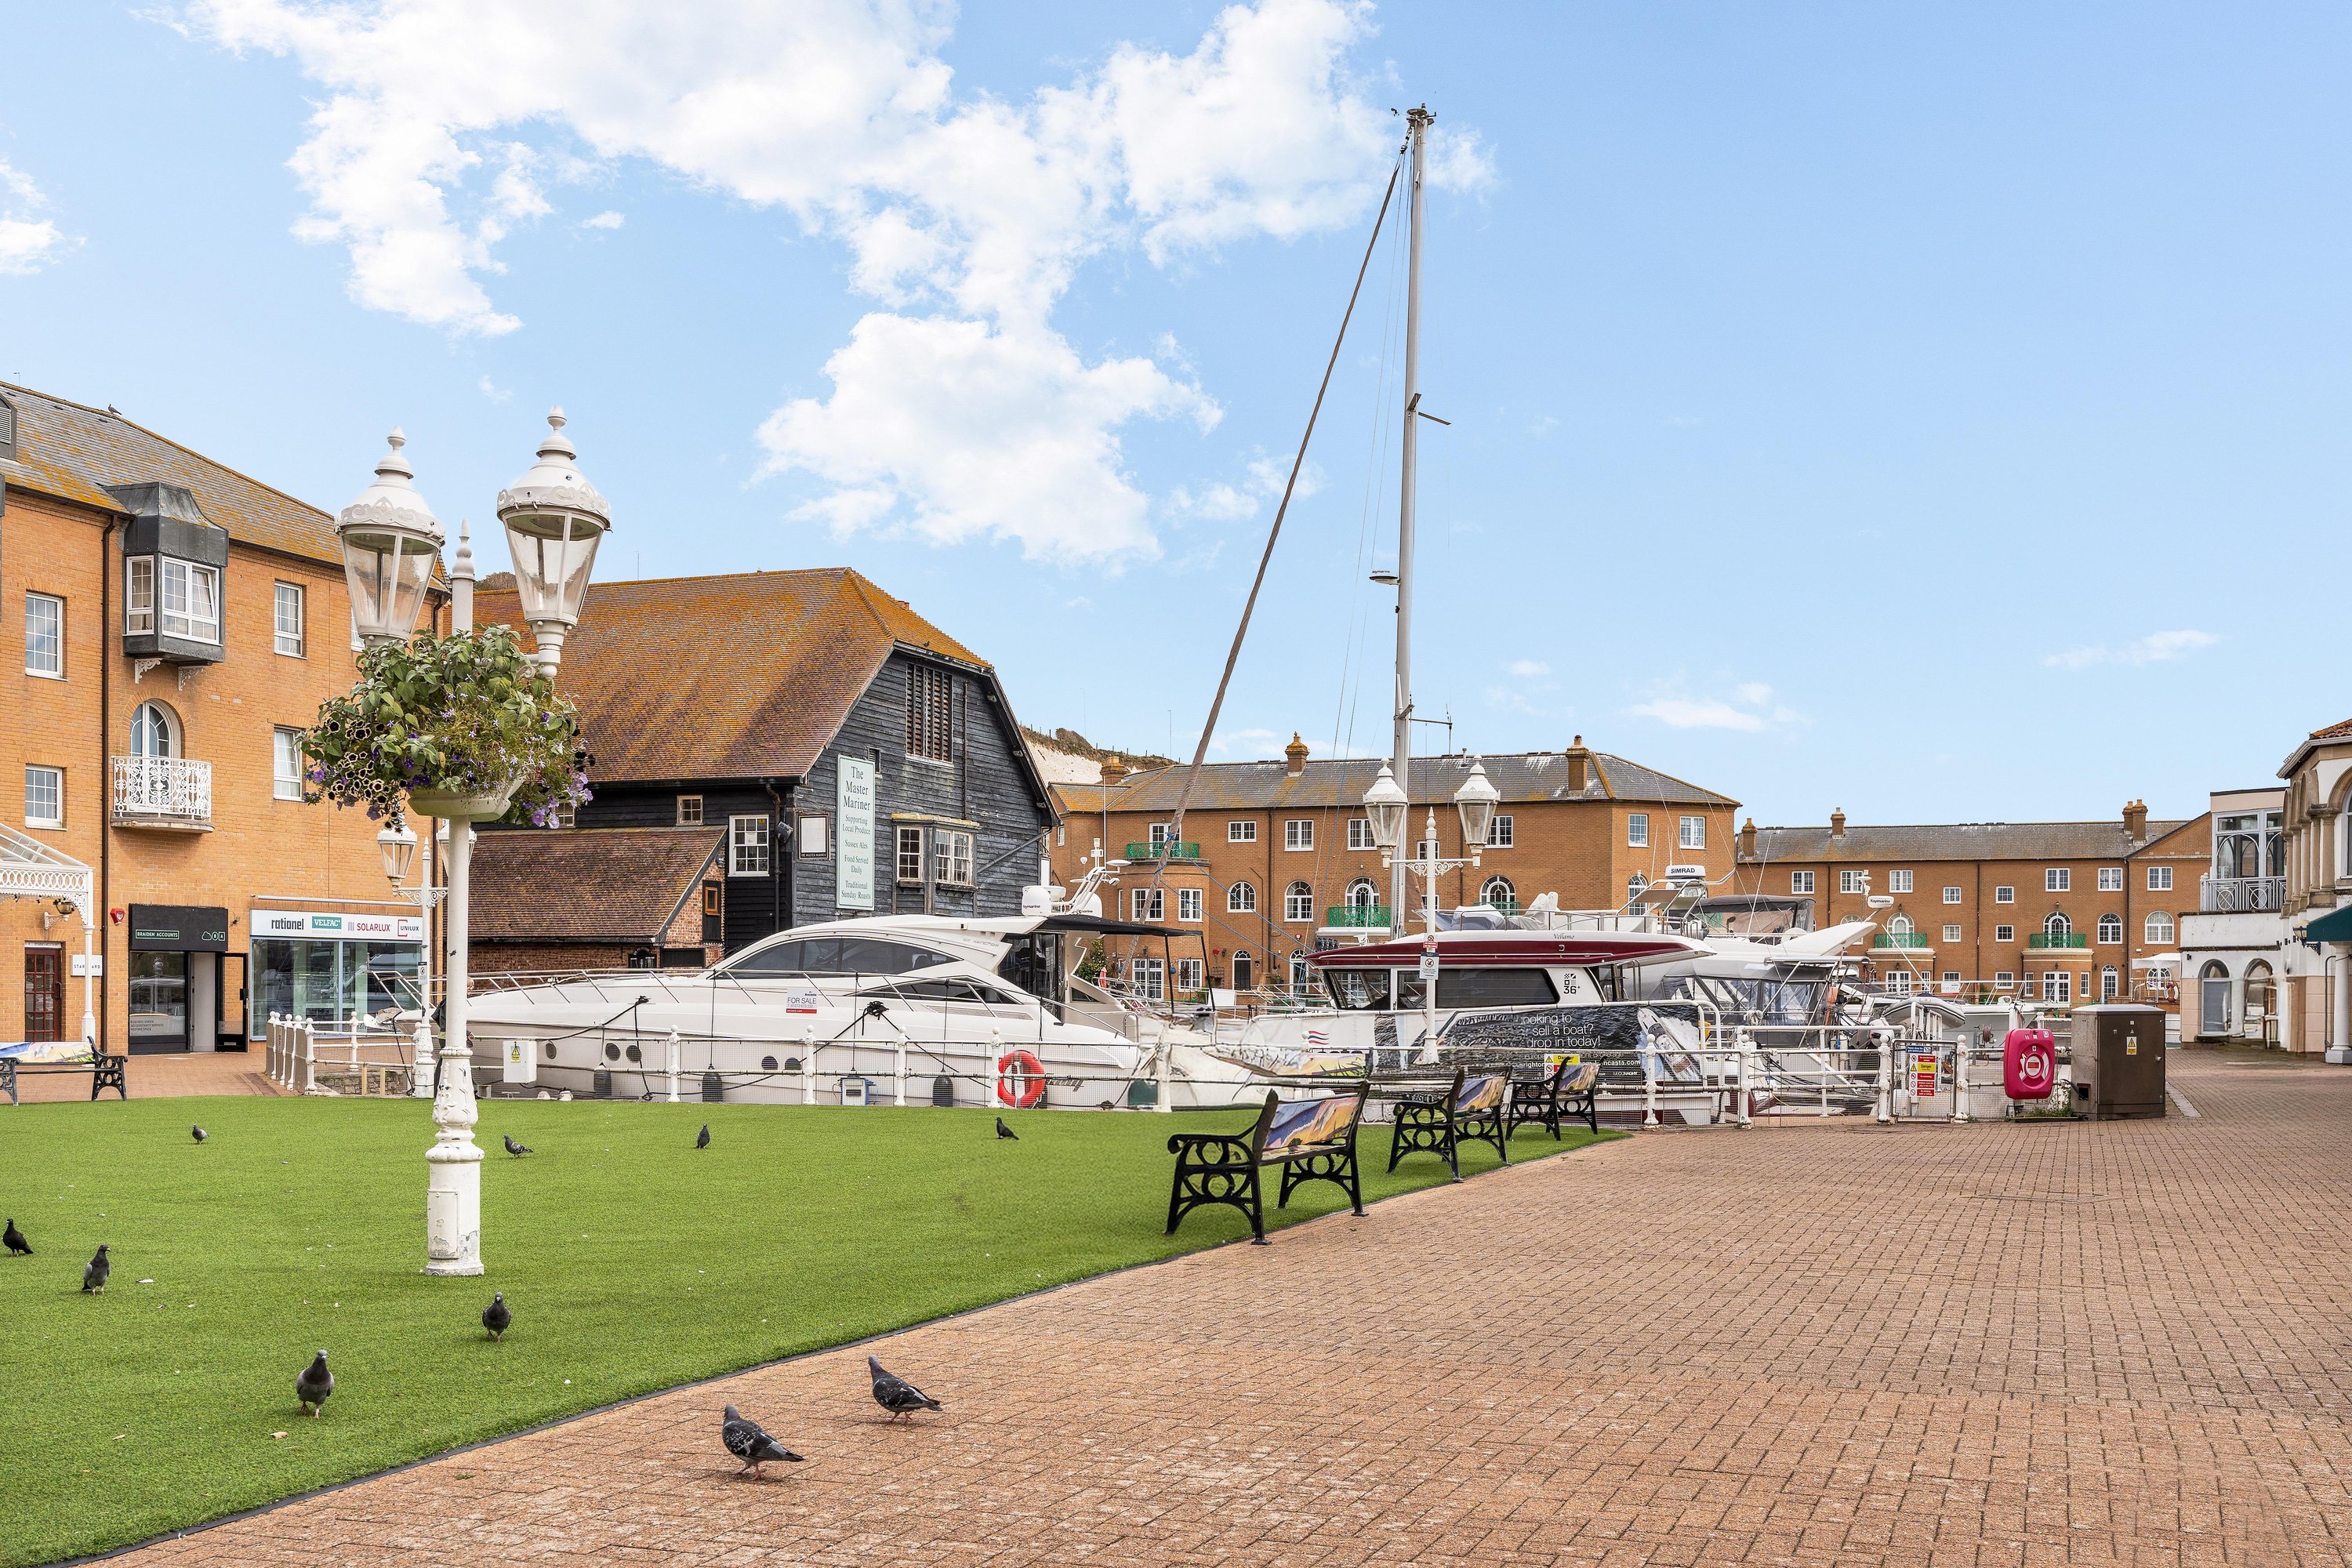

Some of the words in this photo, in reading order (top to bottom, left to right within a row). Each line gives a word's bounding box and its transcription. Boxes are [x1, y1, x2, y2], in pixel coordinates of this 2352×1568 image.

[851, 766, 864, 779] The
[846, 780, 869, 795] Master
[843, 795, 871, 811] Mariner
[845, 814, 868, 826] Supporting
[842, 824, 854, 833] Local
[855, 825, 871, 835] Produce
[844, 839, 858, 848] Sussex
[851, 865, 862, 875] Daily
[845, 880, 868, 890] Traditional
[841, 890, 856, 900] Sunday
[271, 917, 304, 931] rationel
[357, 923, 390, 931] SOLARLUX
[1562, 1013, 1572, 1023] to
[1532, 1025, 1550, 1036] sell
[1563, 1023, 1594, 1035] boat?
[1527, 1037, 1552, 1049] drop
[1555, 1036, 1564, 1047] in
[1568, 1035, 1601, 1048] today!
